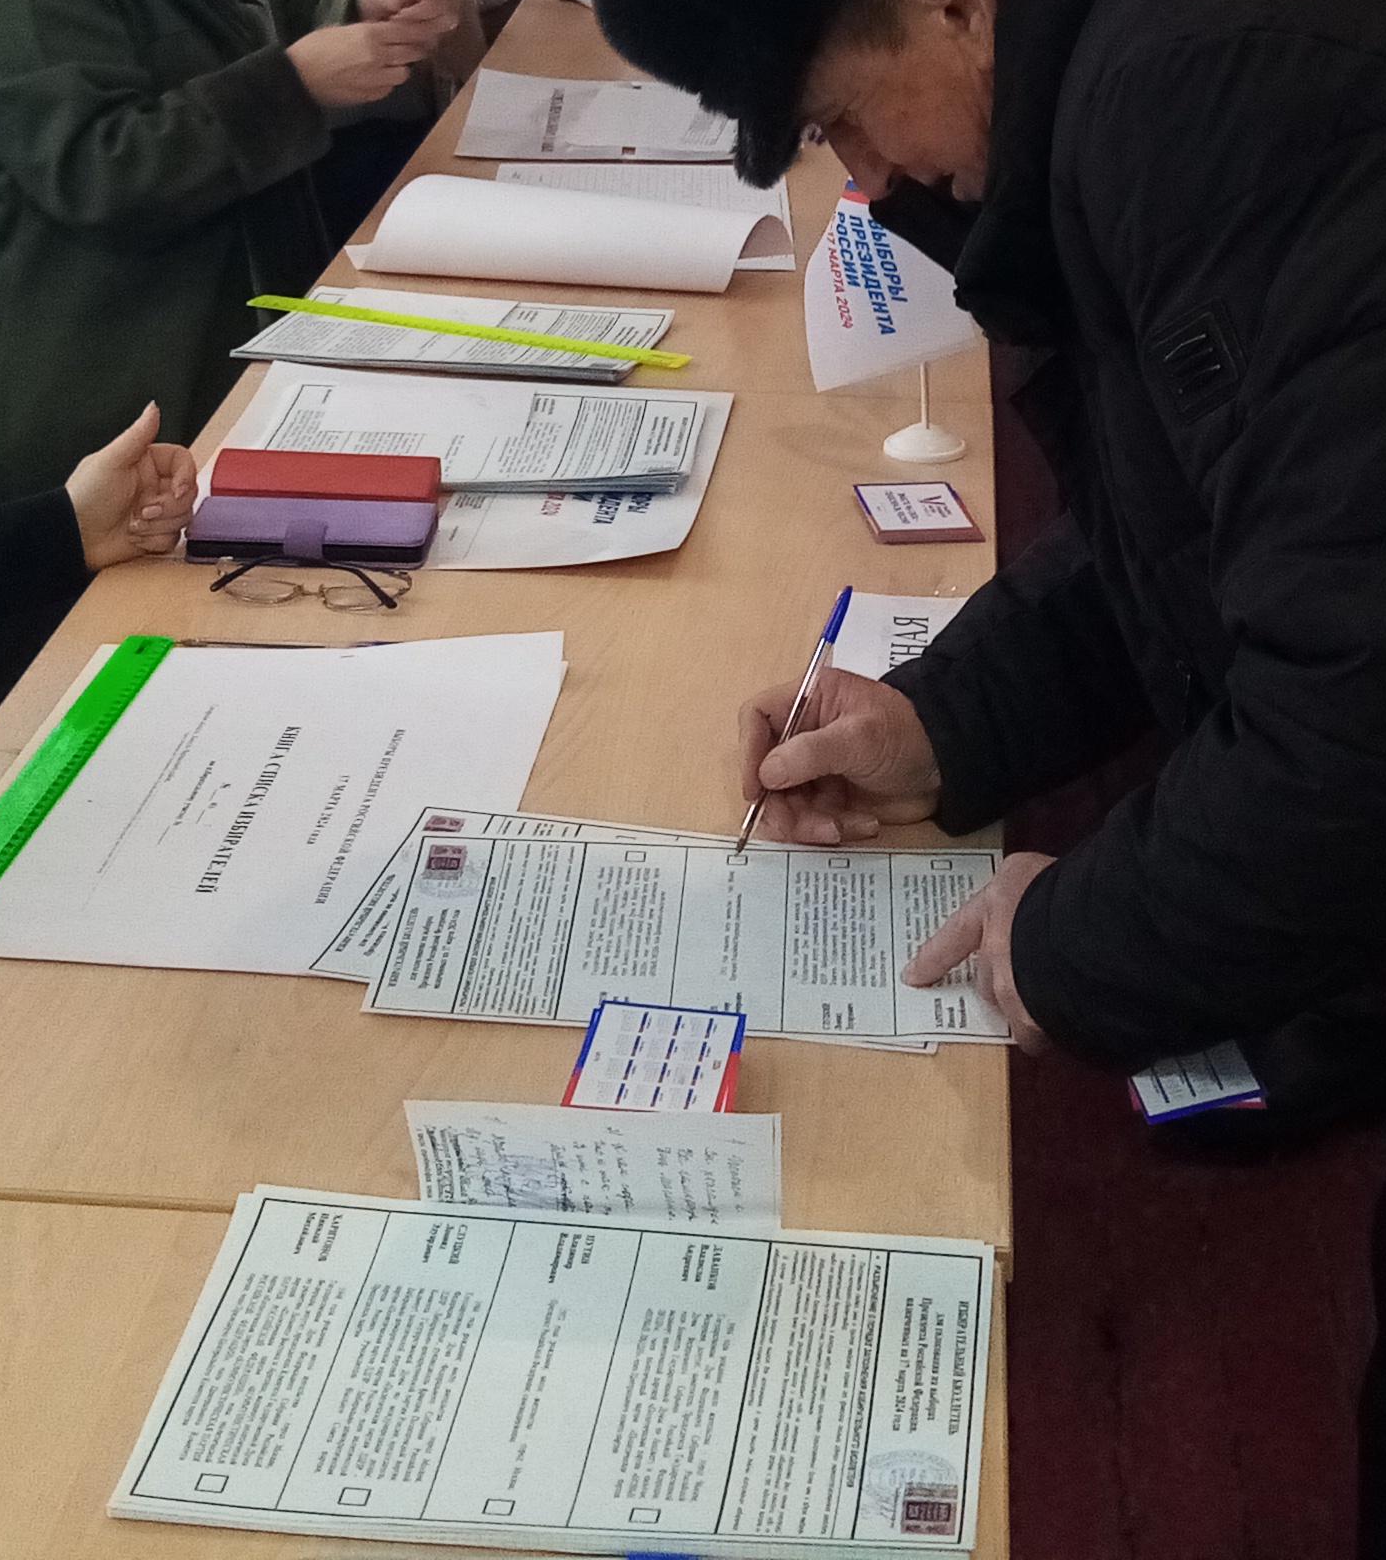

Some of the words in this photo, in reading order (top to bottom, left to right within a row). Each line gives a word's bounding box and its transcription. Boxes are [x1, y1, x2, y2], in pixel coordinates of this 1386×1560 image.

[827, 248, 846, 293] МАРТА
[835, 211, 862, 288] РОССИИ
[868, 218, 908, 303] ВЫБОРЫ
[849, 214, 897, 335] ПРЕЗИДЕНТА
[835, 296, 854, 329] 2024
[268, 725, 302, 760] КНИГА
[382, 728, 406, 756] ВЫБОРЫ
[242, 761, 282, 808] СПИСКА
[322, 784, 345, 811] МАРТА
[361, 756, 392, 803] ПРЕЗИДЕНТА
[194, 810, 256, 894] ИЗБИРАТЕЛЕЙ
[338, 804, 371, 853] РОССИЙСКОЙ
[313, 855, 347, 904] ФЕДЕРАЦИИ
